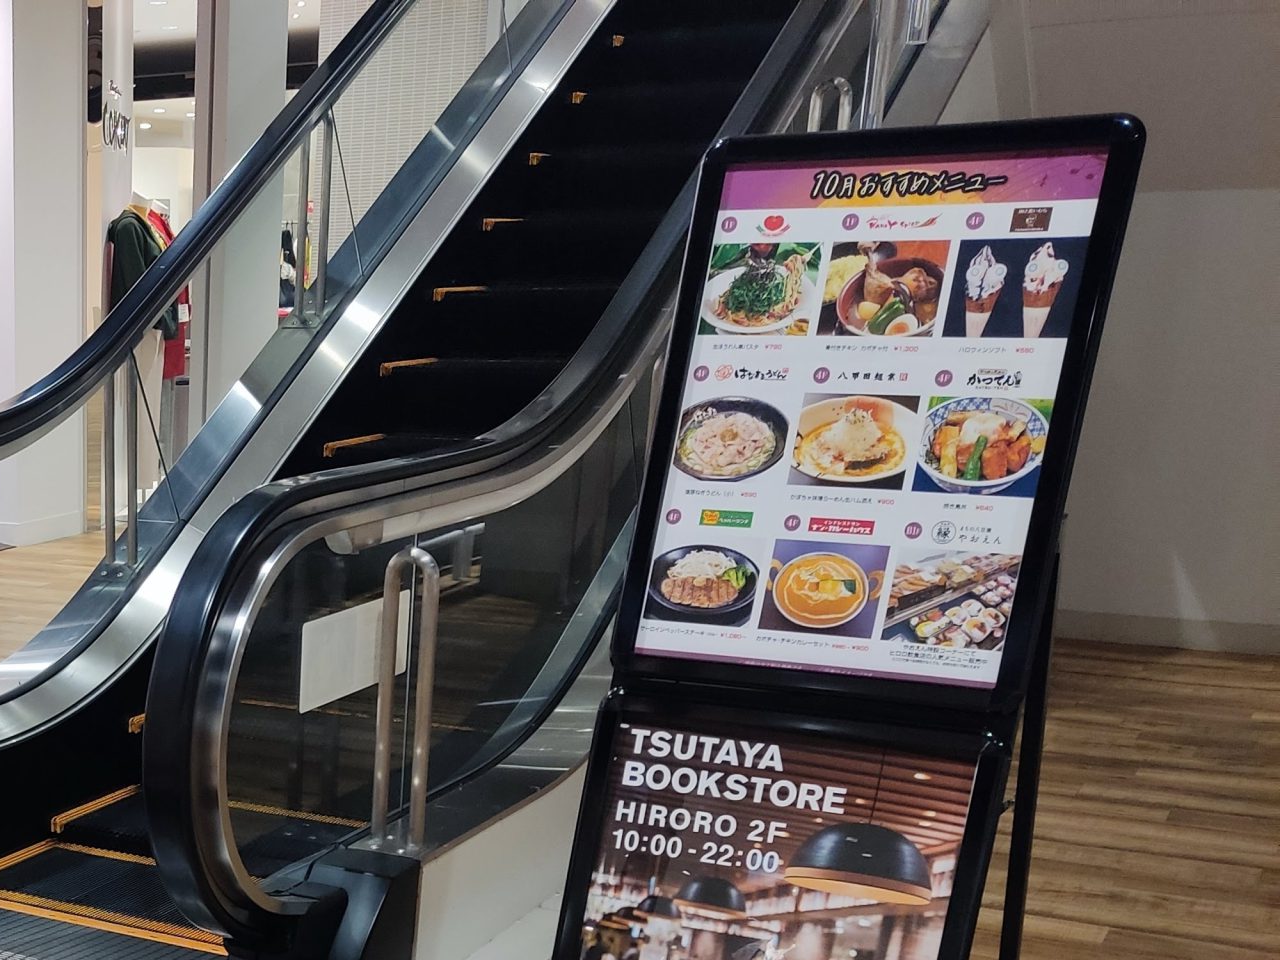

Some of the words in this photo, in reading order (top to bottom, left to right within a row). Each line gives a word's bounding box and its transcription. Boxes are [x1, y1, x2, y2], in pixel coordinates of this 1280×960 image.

[811, 171, 1007, 199] 10月おすすめメニュー
[631, 729, 784, 772] TSUTAYA
[621, 761, 848, 815] BOOKSTORE
[613, 829, 683, 859] 10:00
[615, 801, 738, 838] HIRORO
[747, 819, 788, 844] 2F
